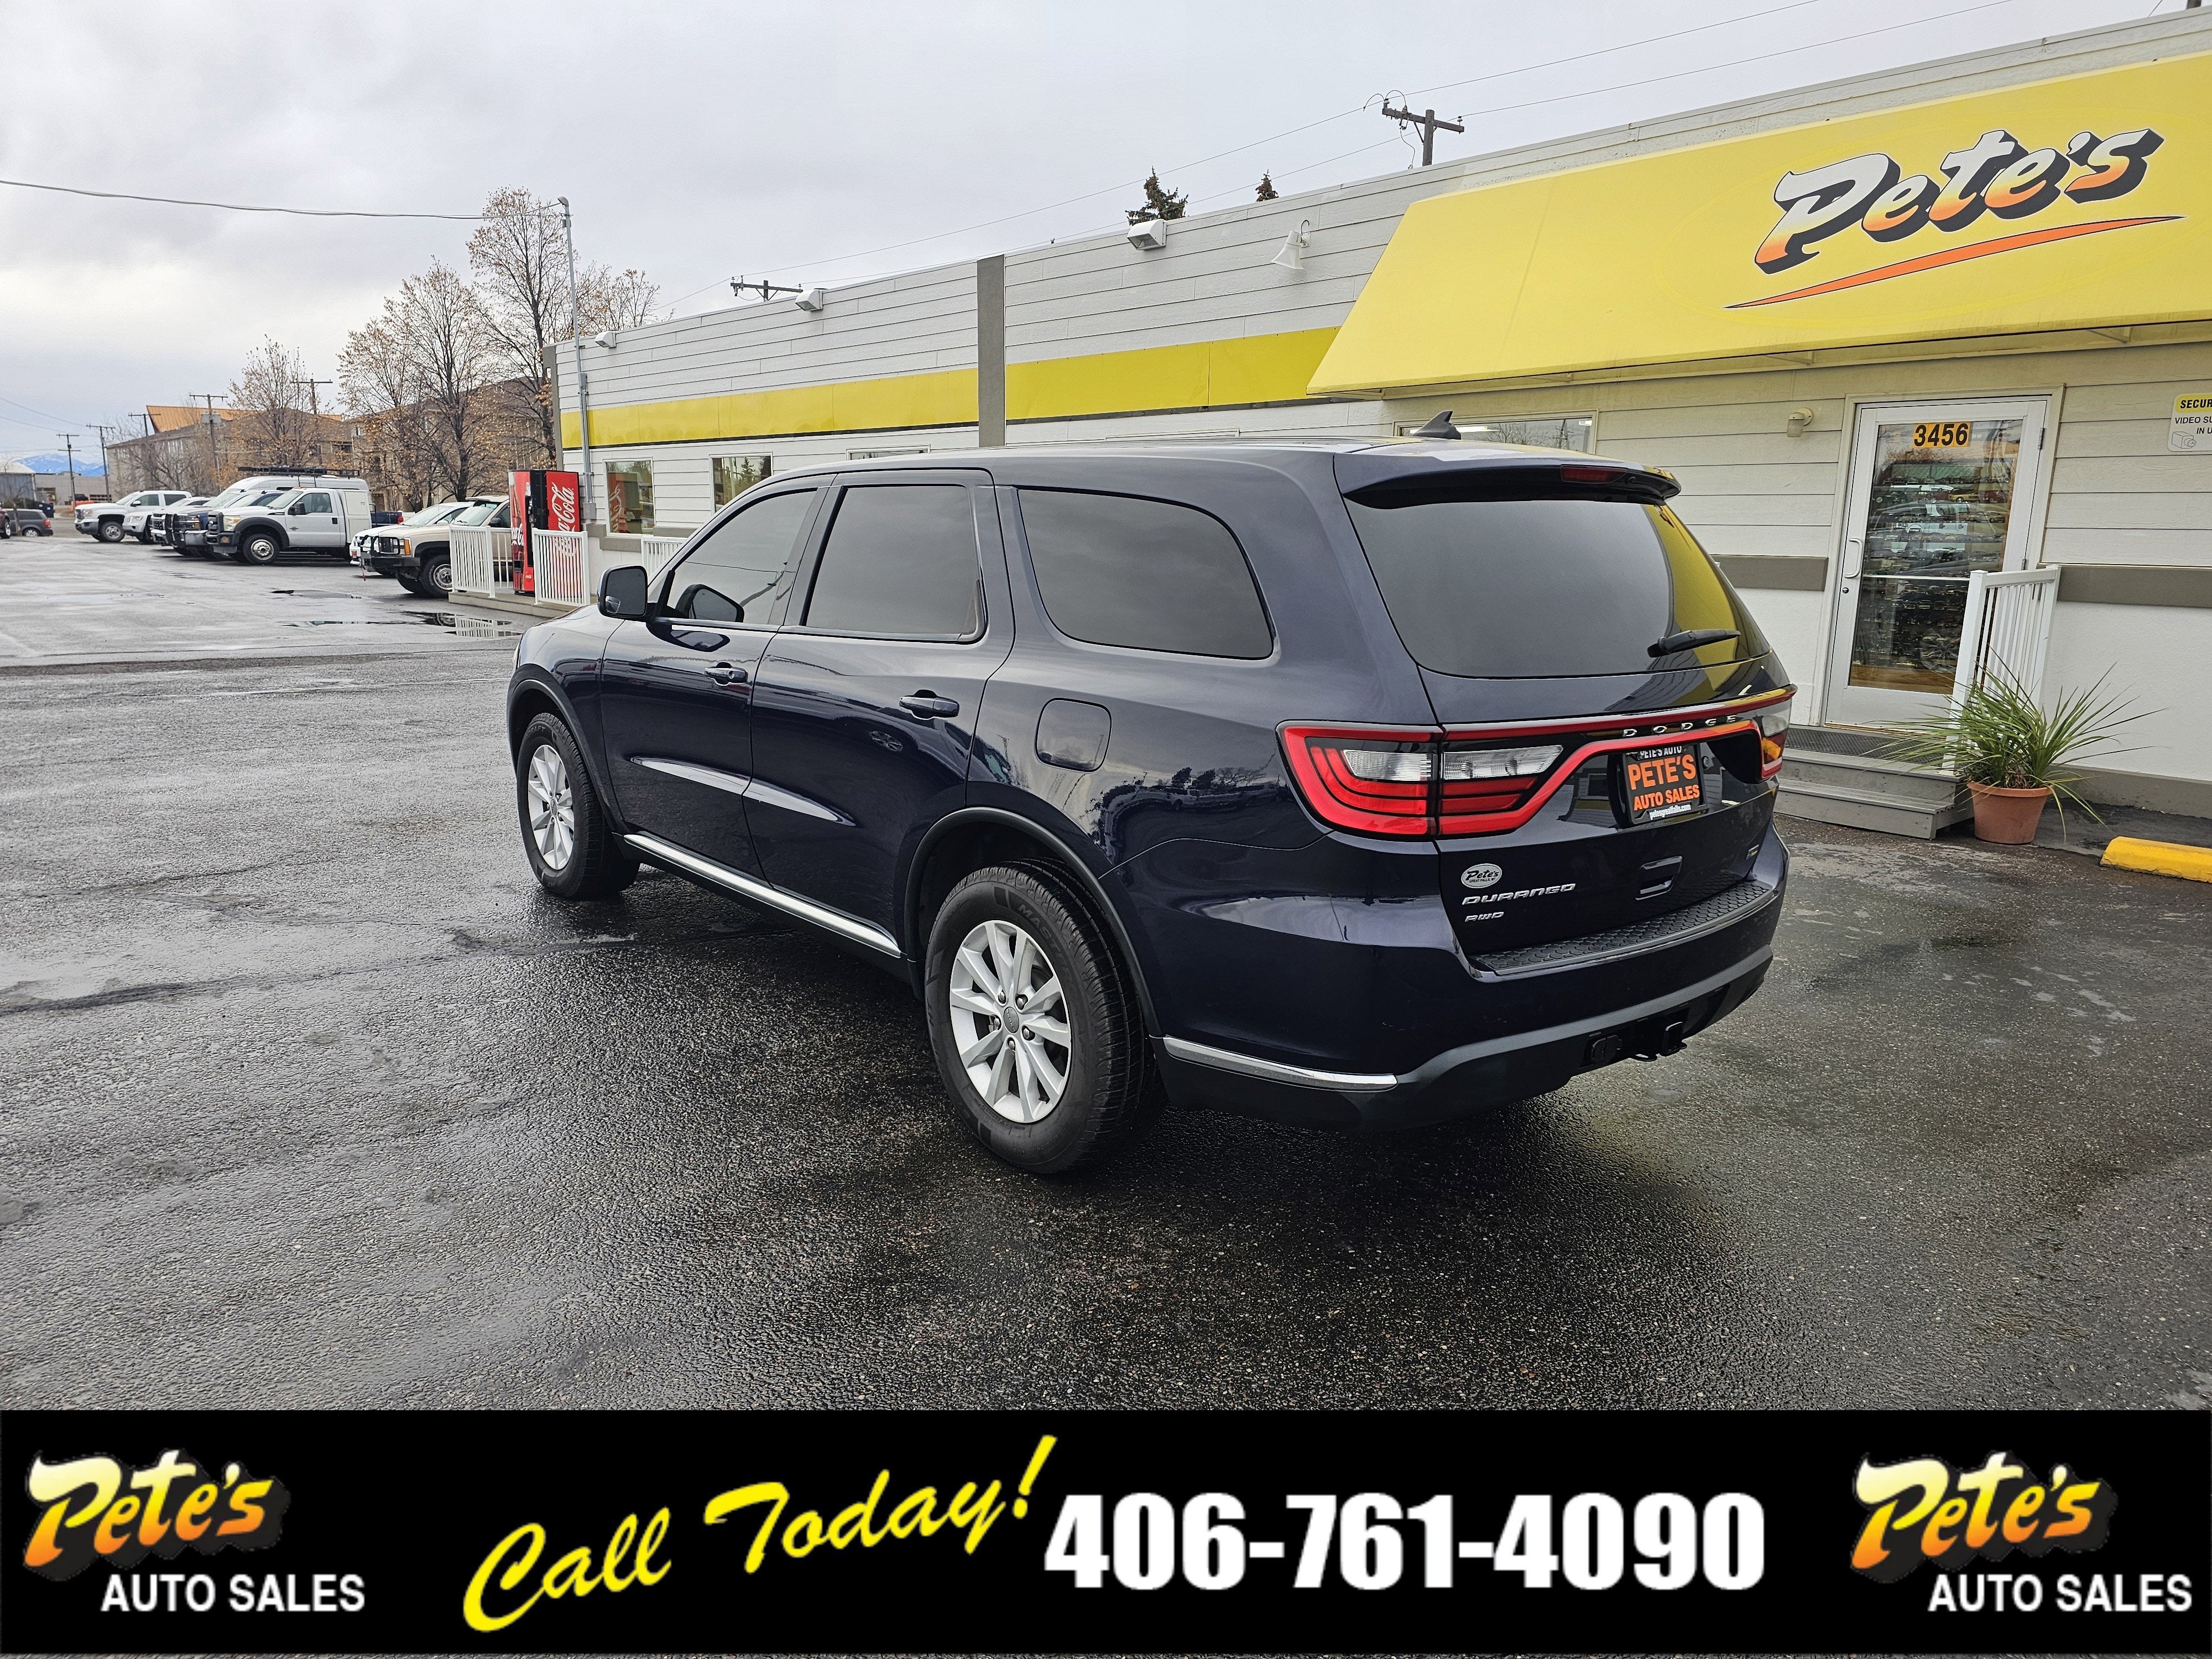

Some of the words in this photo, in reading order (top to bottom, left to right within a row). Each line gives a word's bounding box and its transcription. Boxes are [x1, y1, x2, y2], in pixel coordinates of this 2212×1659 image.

[1755, 128, 2164, 274] Pete's
[2180, 399, 2212, 408] SECUR
[1914, 423, 1969, 447] 3456
[1623, 715, 1736, 737] DODGE
[1627, 754, 1696, 790] PETE'S
[1634, 792, 1663, 811] AUTO
[1665, 784, 1700, 804] SALES
[1650, 804, 1691, 821] petesgreatfalls.com
[1465, 870, 1499, 880] Pete's
[1462, 883, 1576, 905] DURANGO
[1465, 911, 1504, 922] AWD
